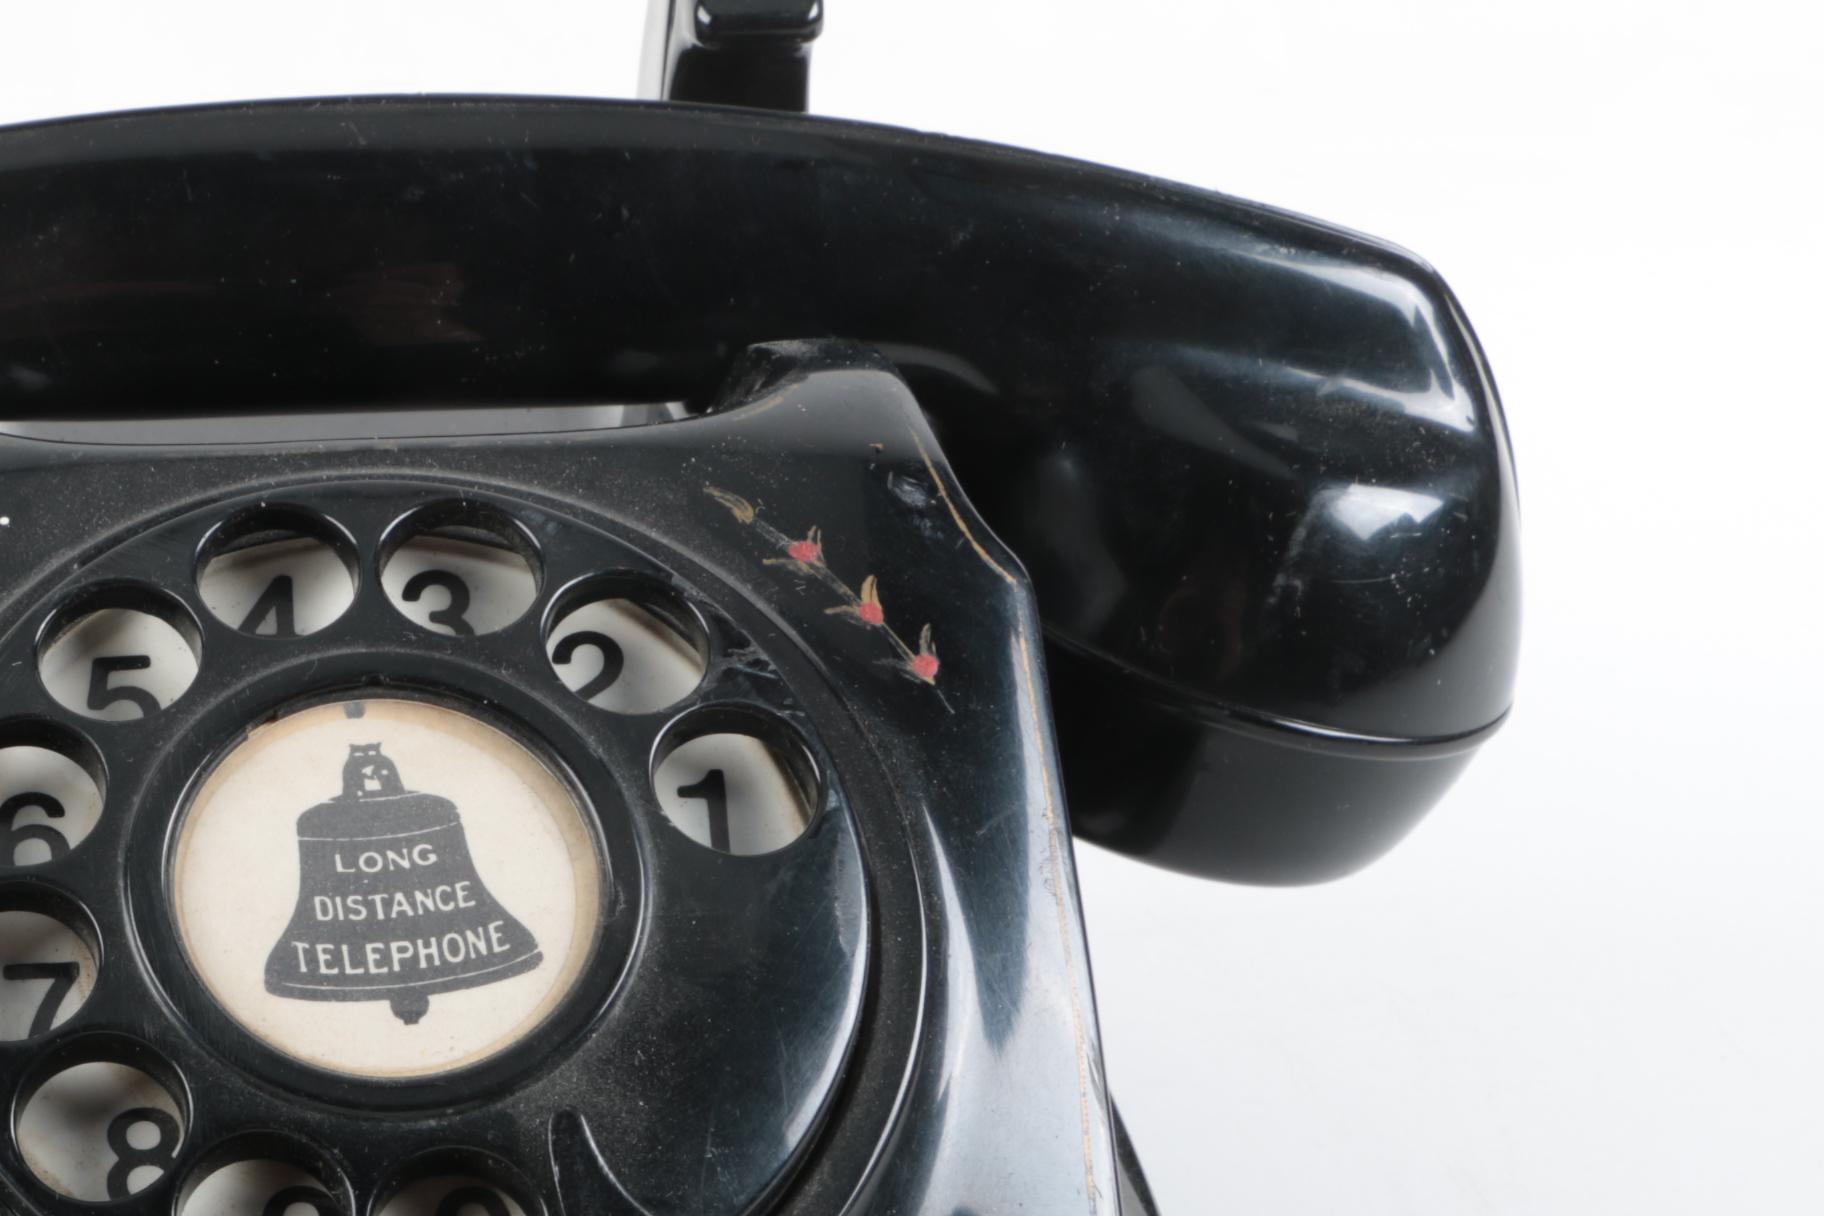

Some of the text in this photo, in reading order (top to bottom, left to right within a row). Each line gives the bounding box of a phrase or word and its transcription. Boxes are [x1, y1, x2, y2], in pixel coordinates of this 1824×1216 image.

[238, 574, 300, 637] 4
[401, 569, 474, 637] 3
[86, 654, 162, 719] 5
[551, 630, 625, 702] 2
[676, 769, 730, 854] 1
[334, 843, 439, 874] LONG
[313, 880, 477, 922] DISTANCE
[291, 920, 512, 976] TELEPHONE
[2, 960, 80, 1041] 7
[106, 1106, 182, 1201] 8
